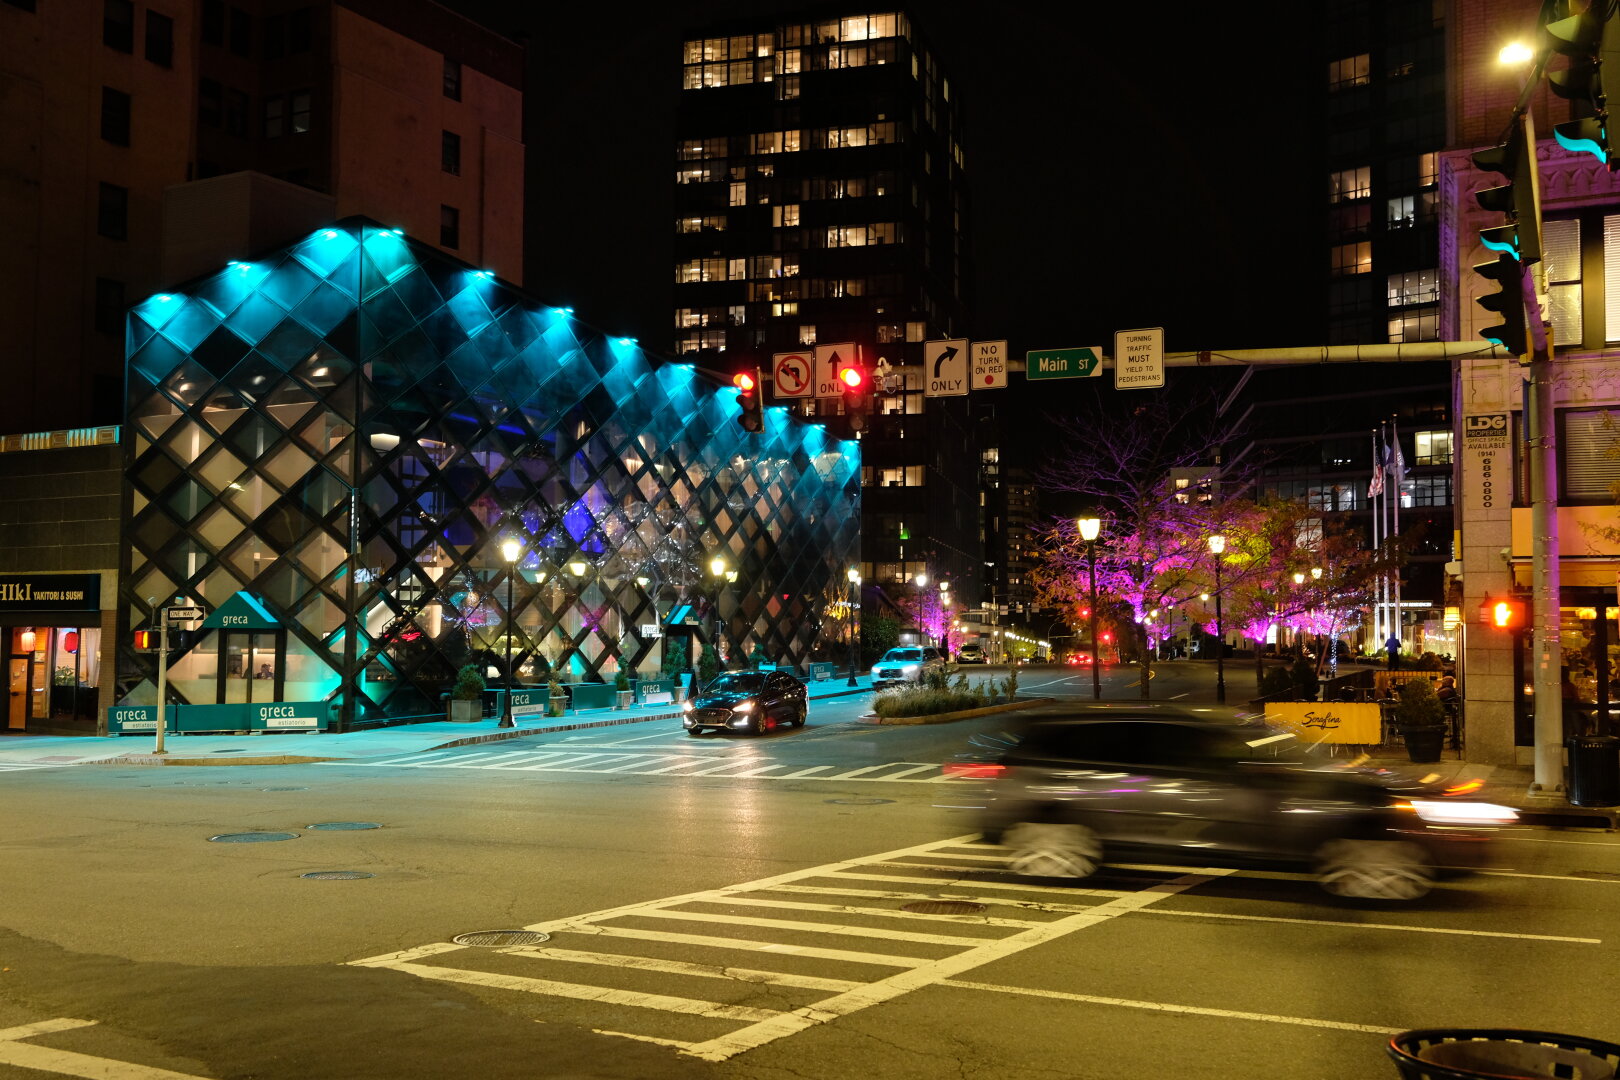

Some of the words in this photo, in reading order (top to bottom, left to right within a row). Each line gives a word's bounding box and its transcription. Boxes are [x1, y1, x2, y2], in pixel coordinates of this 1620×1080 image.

[1126, 335, 1152, 343] TURNING
[981, 345, 998, 355] NO
[978, 357, 999, 365] TURN
[1039, 356, 1068, 372] Main
[1078, 358, 1090, 370] ST
[1128, 354, 1150, 363] MUST
[975, 367, 986, 375] ON
[988, 365, 1004, 374] RED
[1118, 374, 1161, 383] PEDESTRIANS
[820, 383, 843, 394] ONL
[931, 380, 962, 392] ONLY
[1467, 416, 1506, 429] LDG
[33, 591, 60, 601] YAKITORI
[60, 591, 65, 601] &
[65, 591, 84, 601] SUSHI
[222, 615, 249, 627] greca
[642, 683, 661, 697] greca
[511, 694, 530, 705] reca
[116, 710, 147, 724] greca
[259, 706, 295, 721] greca
